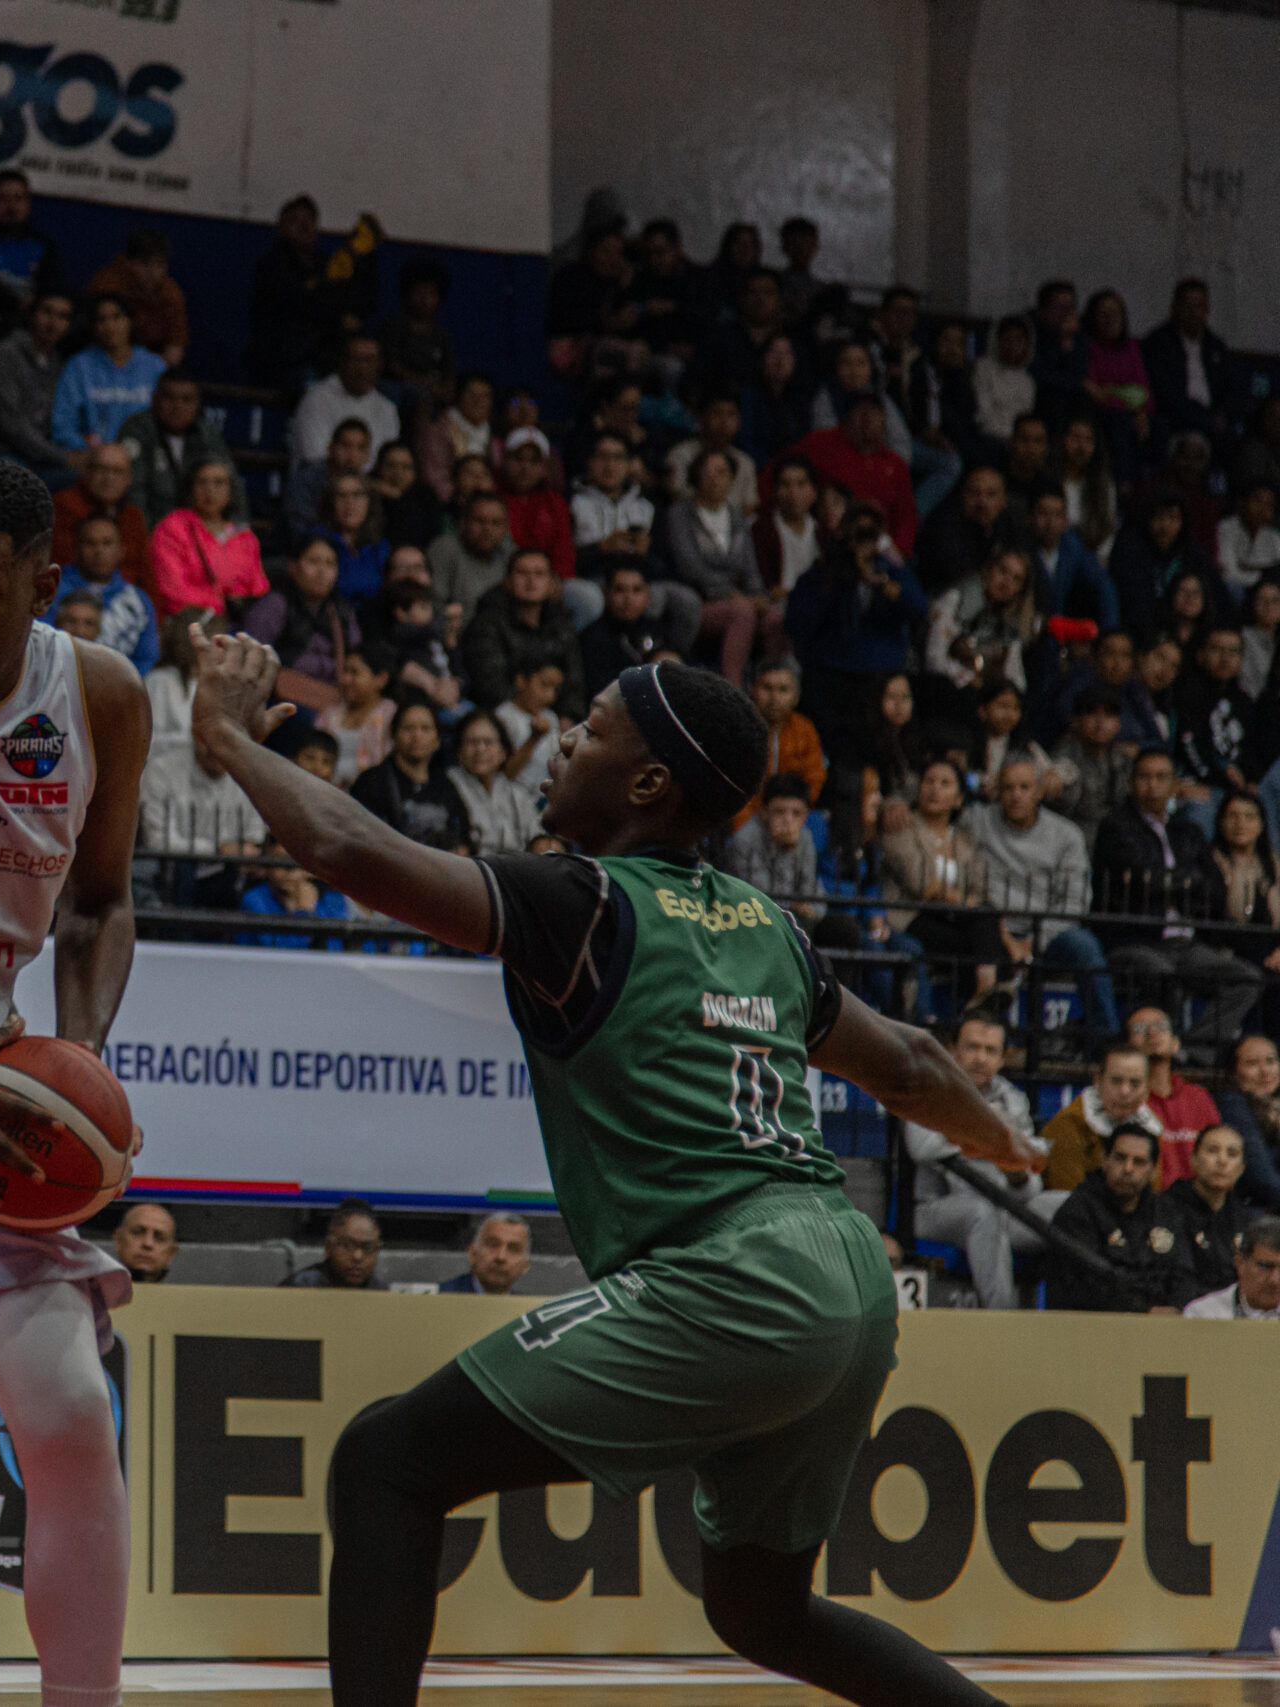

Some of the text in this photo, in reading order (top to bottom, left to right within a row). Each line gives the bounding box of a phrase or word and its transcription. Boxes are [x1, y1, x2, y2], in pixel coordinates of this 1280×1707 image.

[270, 1051, 448, 1096] DEPORTIVA
[457, 1060, 497, 1097] DE
[513, 1285, 613, 1352] 4
[173, 1334, 1214, 1603] Eubet
